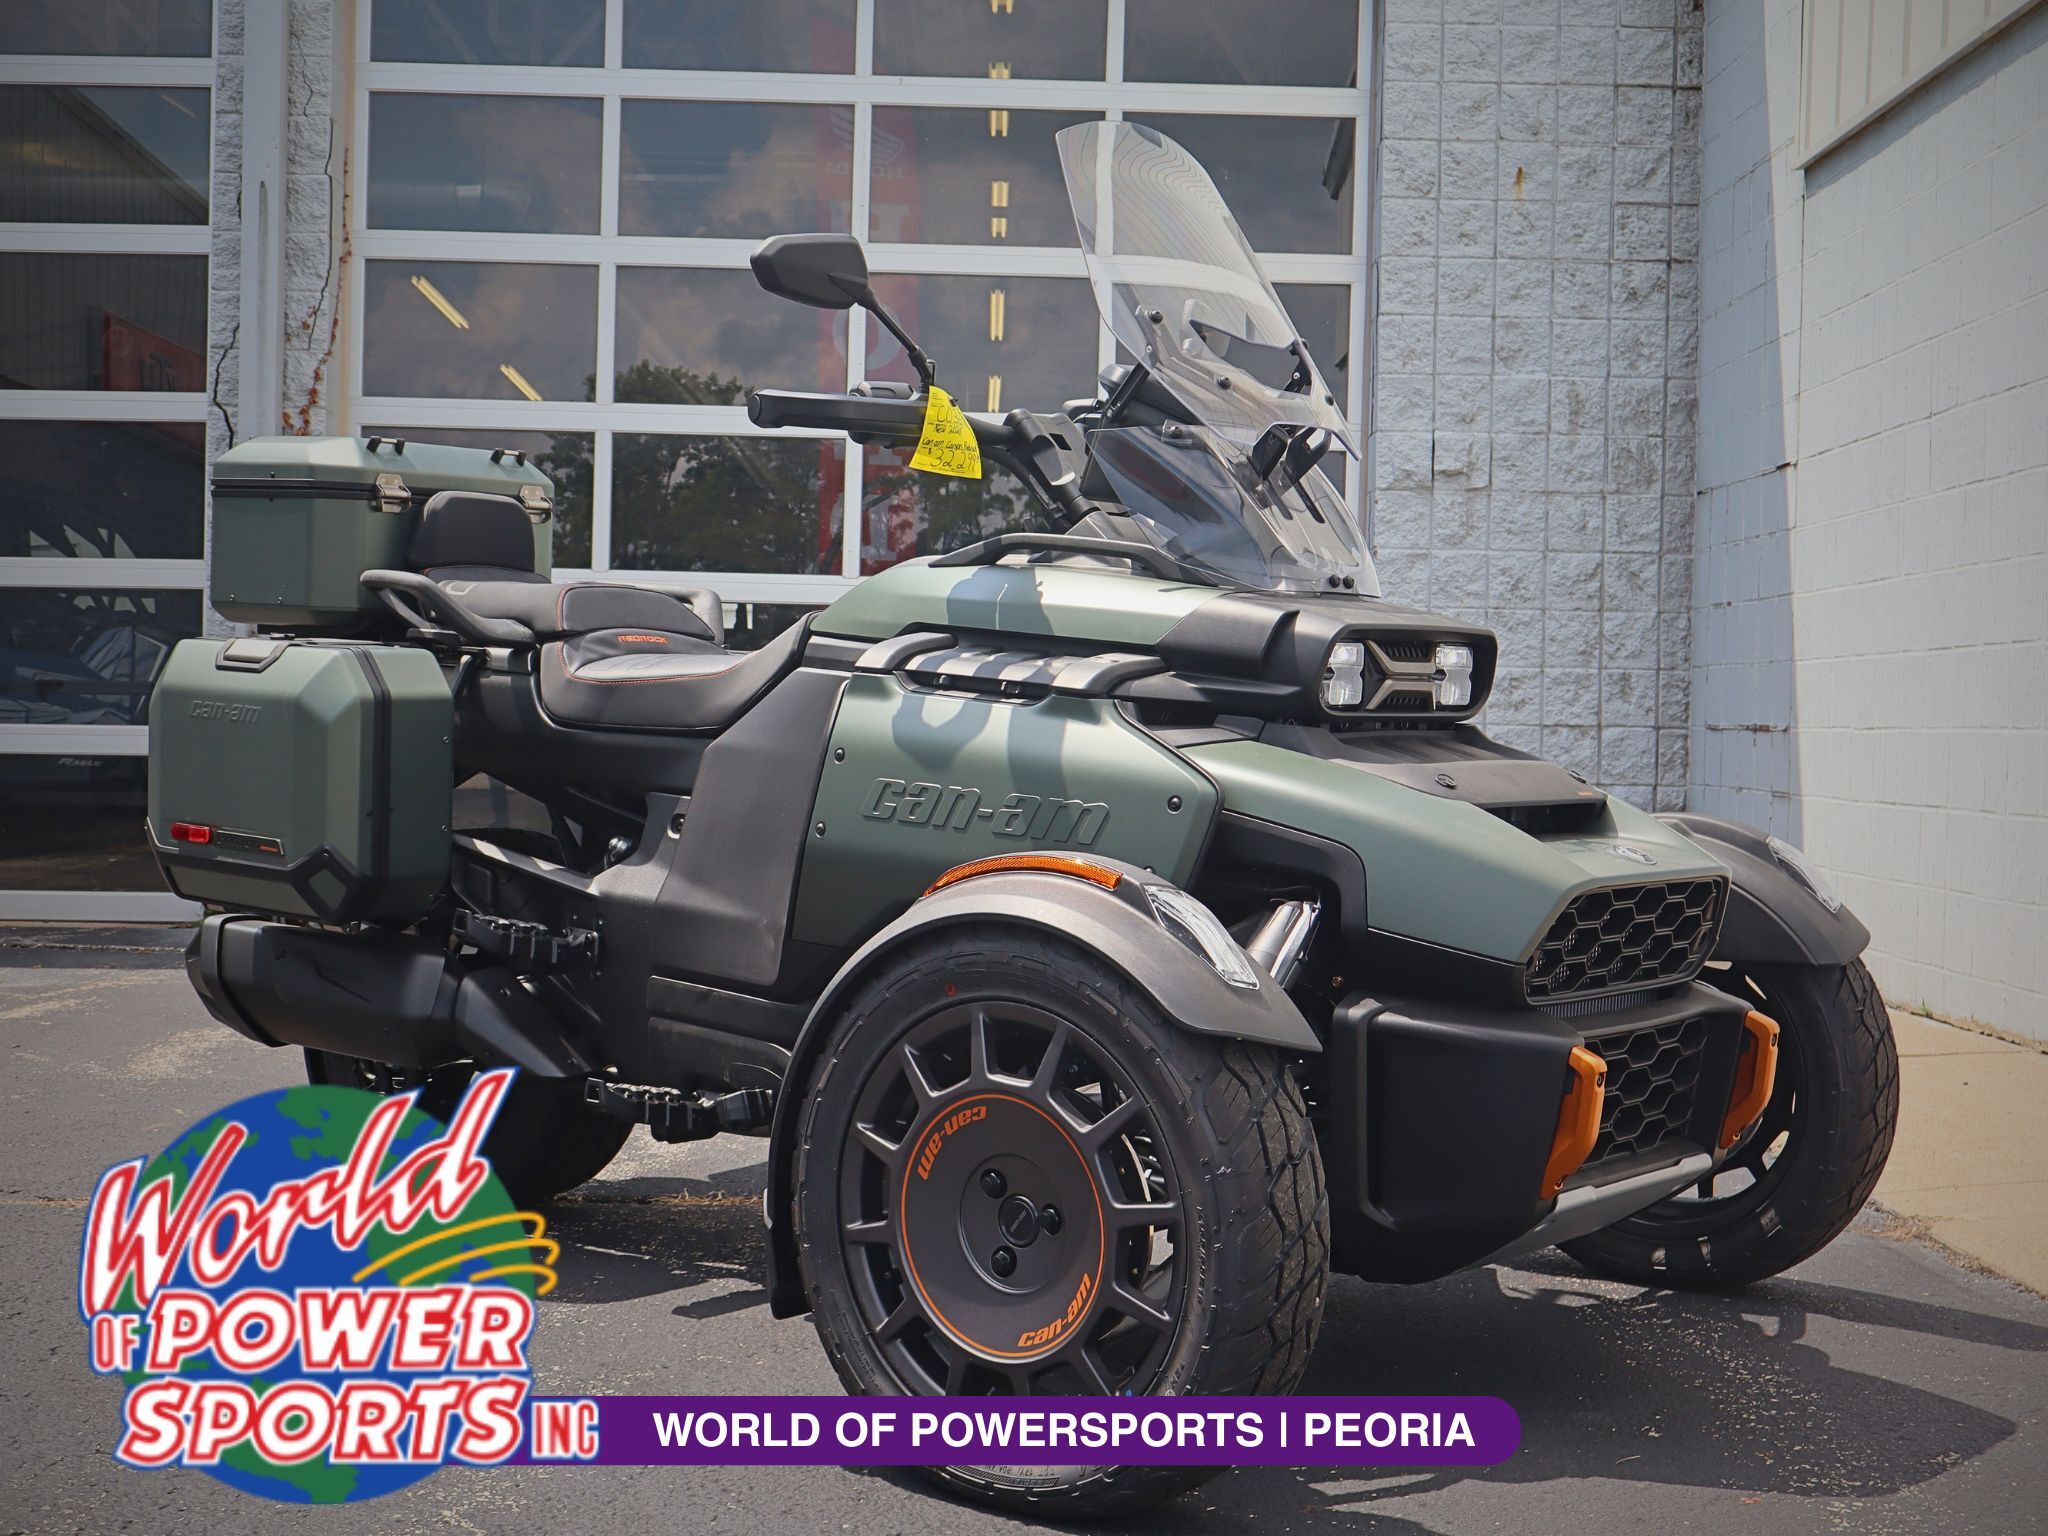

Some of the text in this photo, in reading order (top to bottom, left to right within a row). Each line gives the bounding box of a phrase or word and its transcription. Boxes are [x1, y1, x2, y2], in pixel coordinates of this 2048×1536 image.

[617, 635, 668, 644] REDROCK
[190, 700, 262, 723] can-am
[862, 777, 1110, 845] can-am
[917, 1106, 987, 1180] can-am
[1017, 1272, 1091, 1347] can-am
